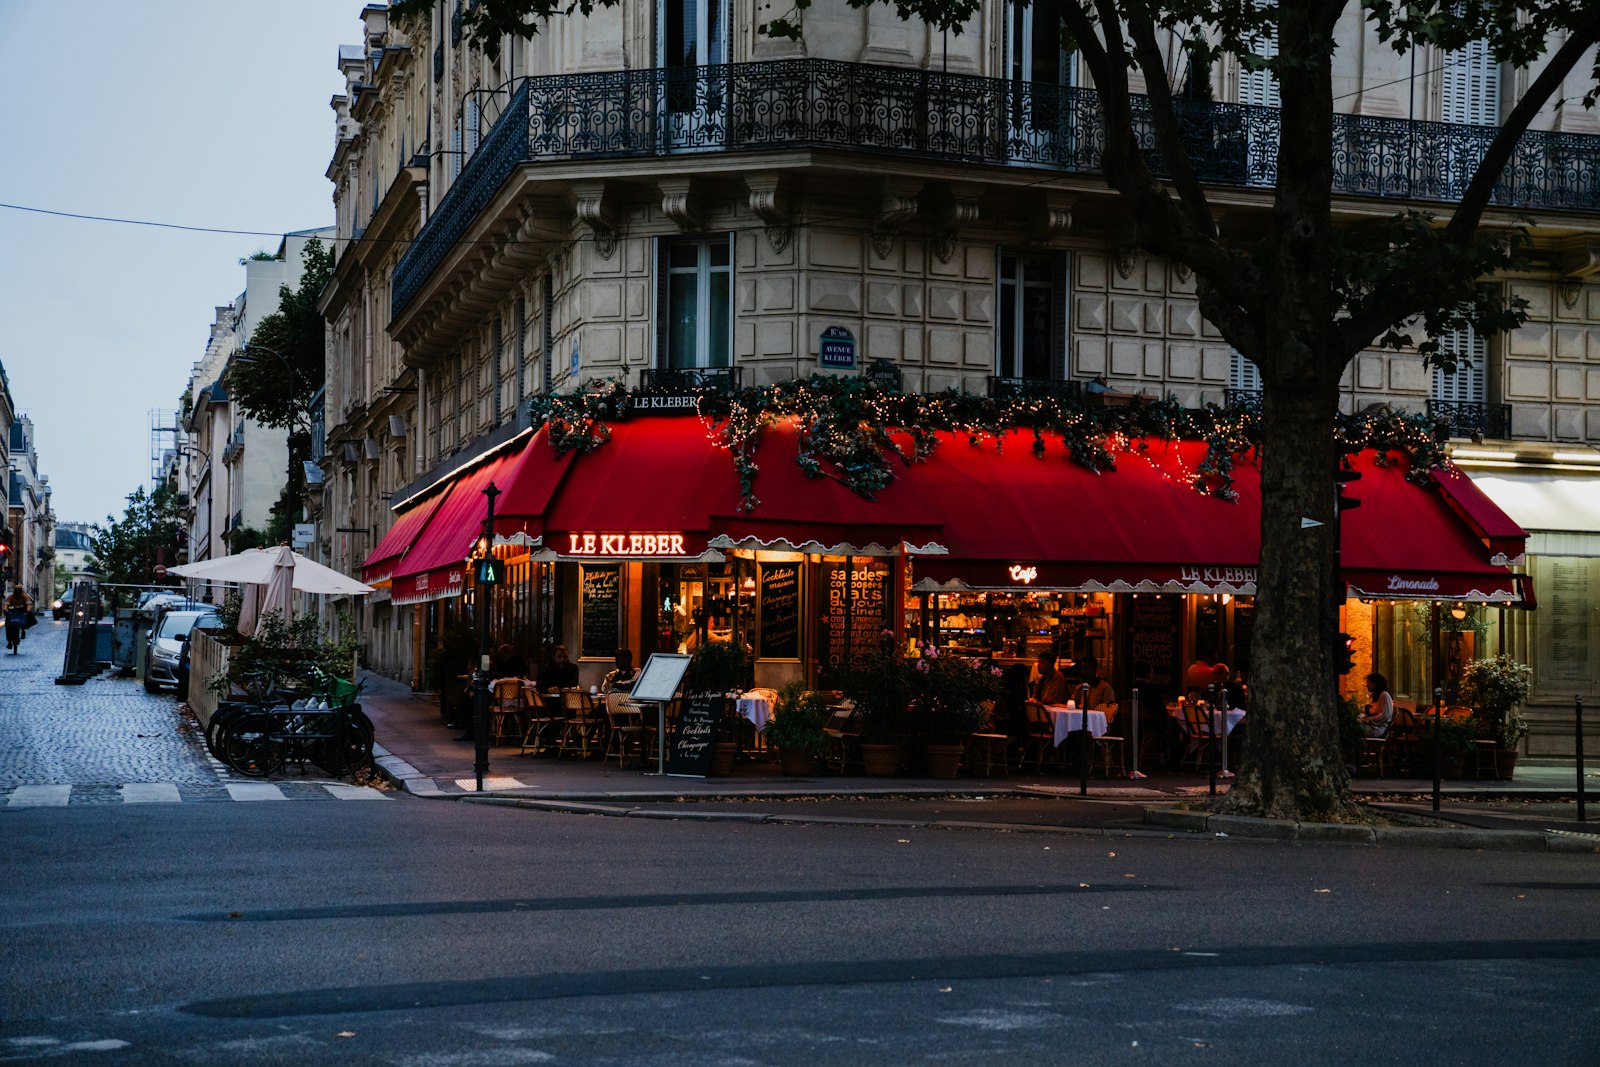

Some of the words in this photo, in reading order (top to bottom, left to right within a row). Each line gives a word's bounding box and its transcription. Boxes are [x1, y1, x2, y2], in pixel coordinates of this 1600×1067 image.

[825, 345, 852, 354] AVENUE
[824, 352, 852, 363] KLÉBER
[633, 397, 649, 409] LE
[650, 396, 698, 408] KLEBER
[569, 533, 597, 554] LE
[600, 533, 687, 555] KLEBER
[762, 568, 795, 583] Cocktails
[830, 566, 883, 581] saades
[1008, 564, 1038, 585] Café
[1181, 566, 1201, 581] LE
[1387, 574, 1440, 591] Limonade
[830, 587, 883, 601] plats
[1133, 628, 1172, 643] whiskies
